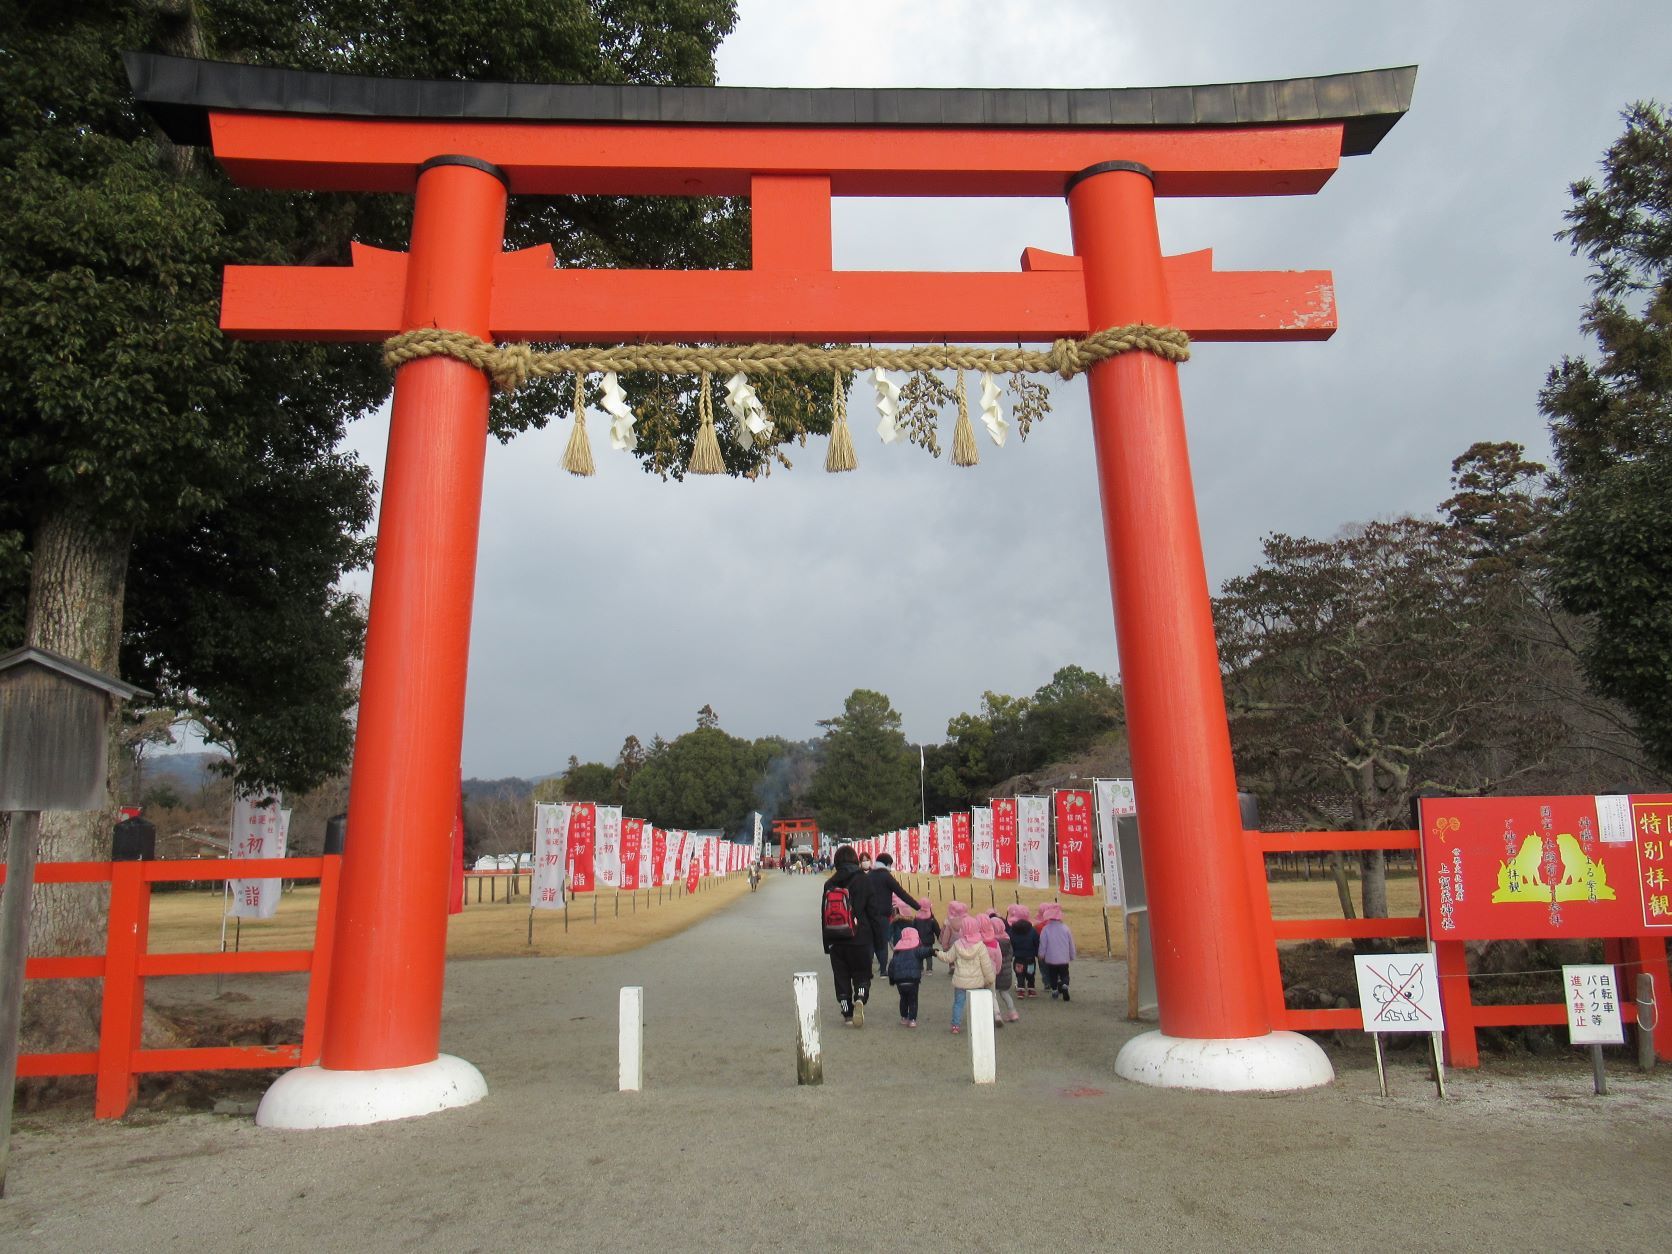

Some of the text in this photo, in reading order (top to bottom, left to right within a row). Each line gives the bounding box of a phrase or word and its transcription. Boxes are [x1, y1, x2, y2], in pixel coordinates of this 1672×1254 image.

[244, 833, 264, 906] 初詣
[542, 851, 558, 902] 初詣
[573, 842, 586, 886] 初詣
[603, 842, 614, 881] 初詣
[626, 850, 636, 885] 初詣
[980, 840, 990, 875] 初詣
[1000, 835, 1012, 874] 初詣
[1027, 838, 1040, 882] 初詣
[1068, 837, 1084, 889] 初詣
[1640, 812, 1672, 918] 特別拝観
[1438, 863, 1455, 931] 上賀茂神社
[1570, 975, 1588, 1027] 進入禁止
[1586, 974, 1602, 1027] バイク等
[1600, 974, 1615, 1013] 自転車
